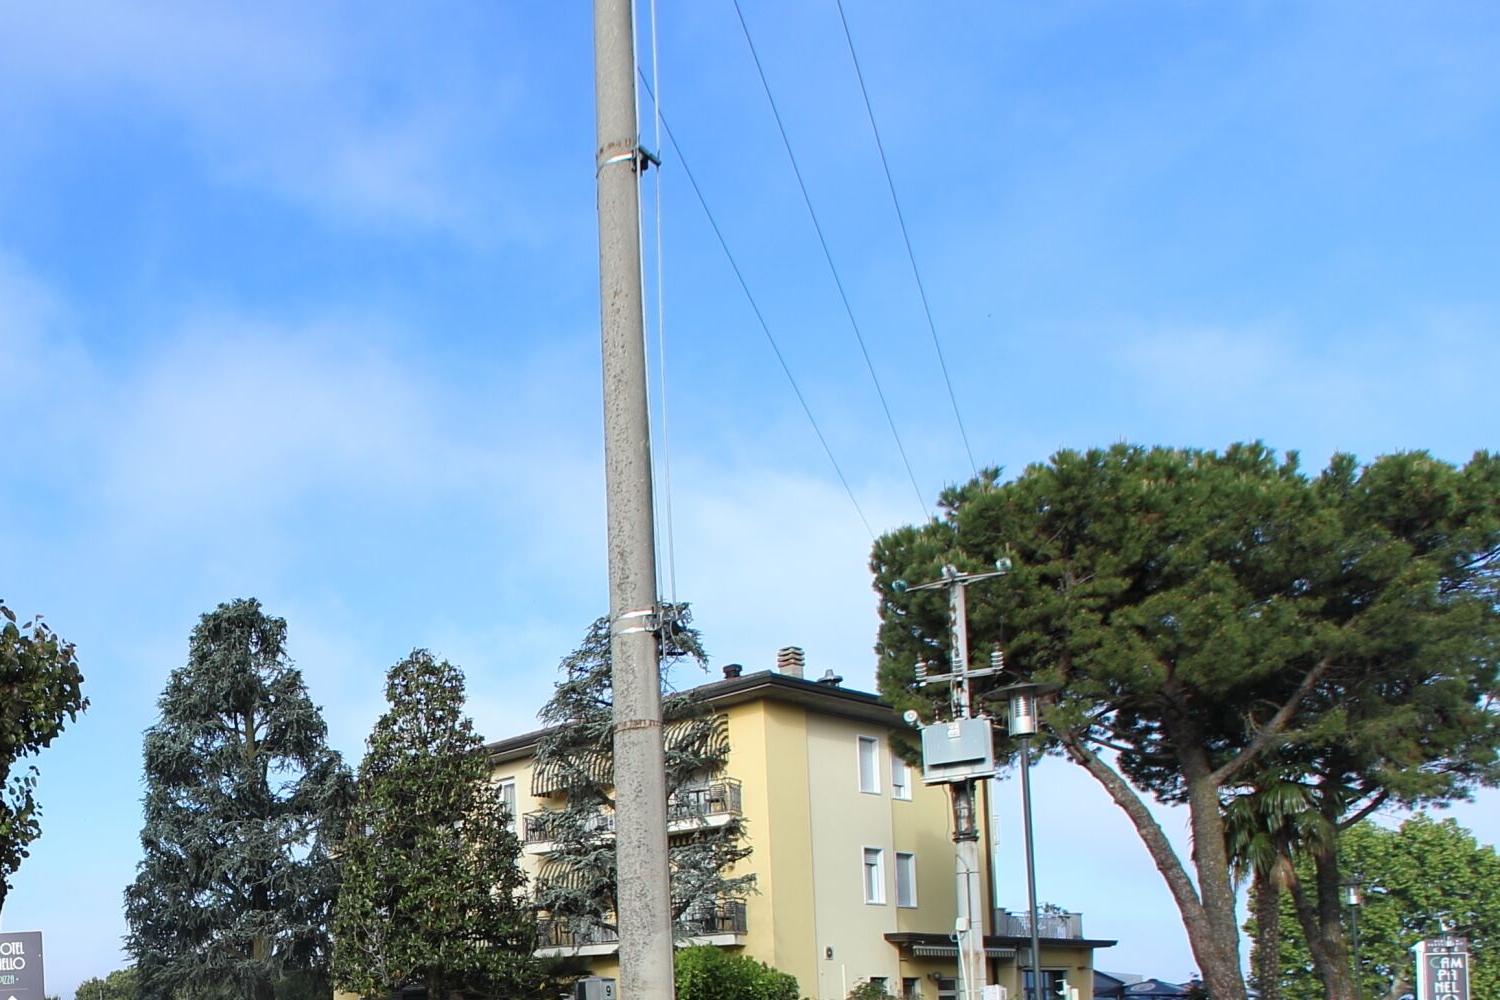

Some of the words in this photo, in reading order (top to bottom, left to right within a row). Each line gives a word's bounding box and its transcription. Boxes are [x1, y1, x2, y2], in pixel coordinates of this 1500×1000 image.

[1430, 956, 1463, 969] CAM
[606, 985, 611, 996] 9
[1434, 982, 1460, 993] NEL
